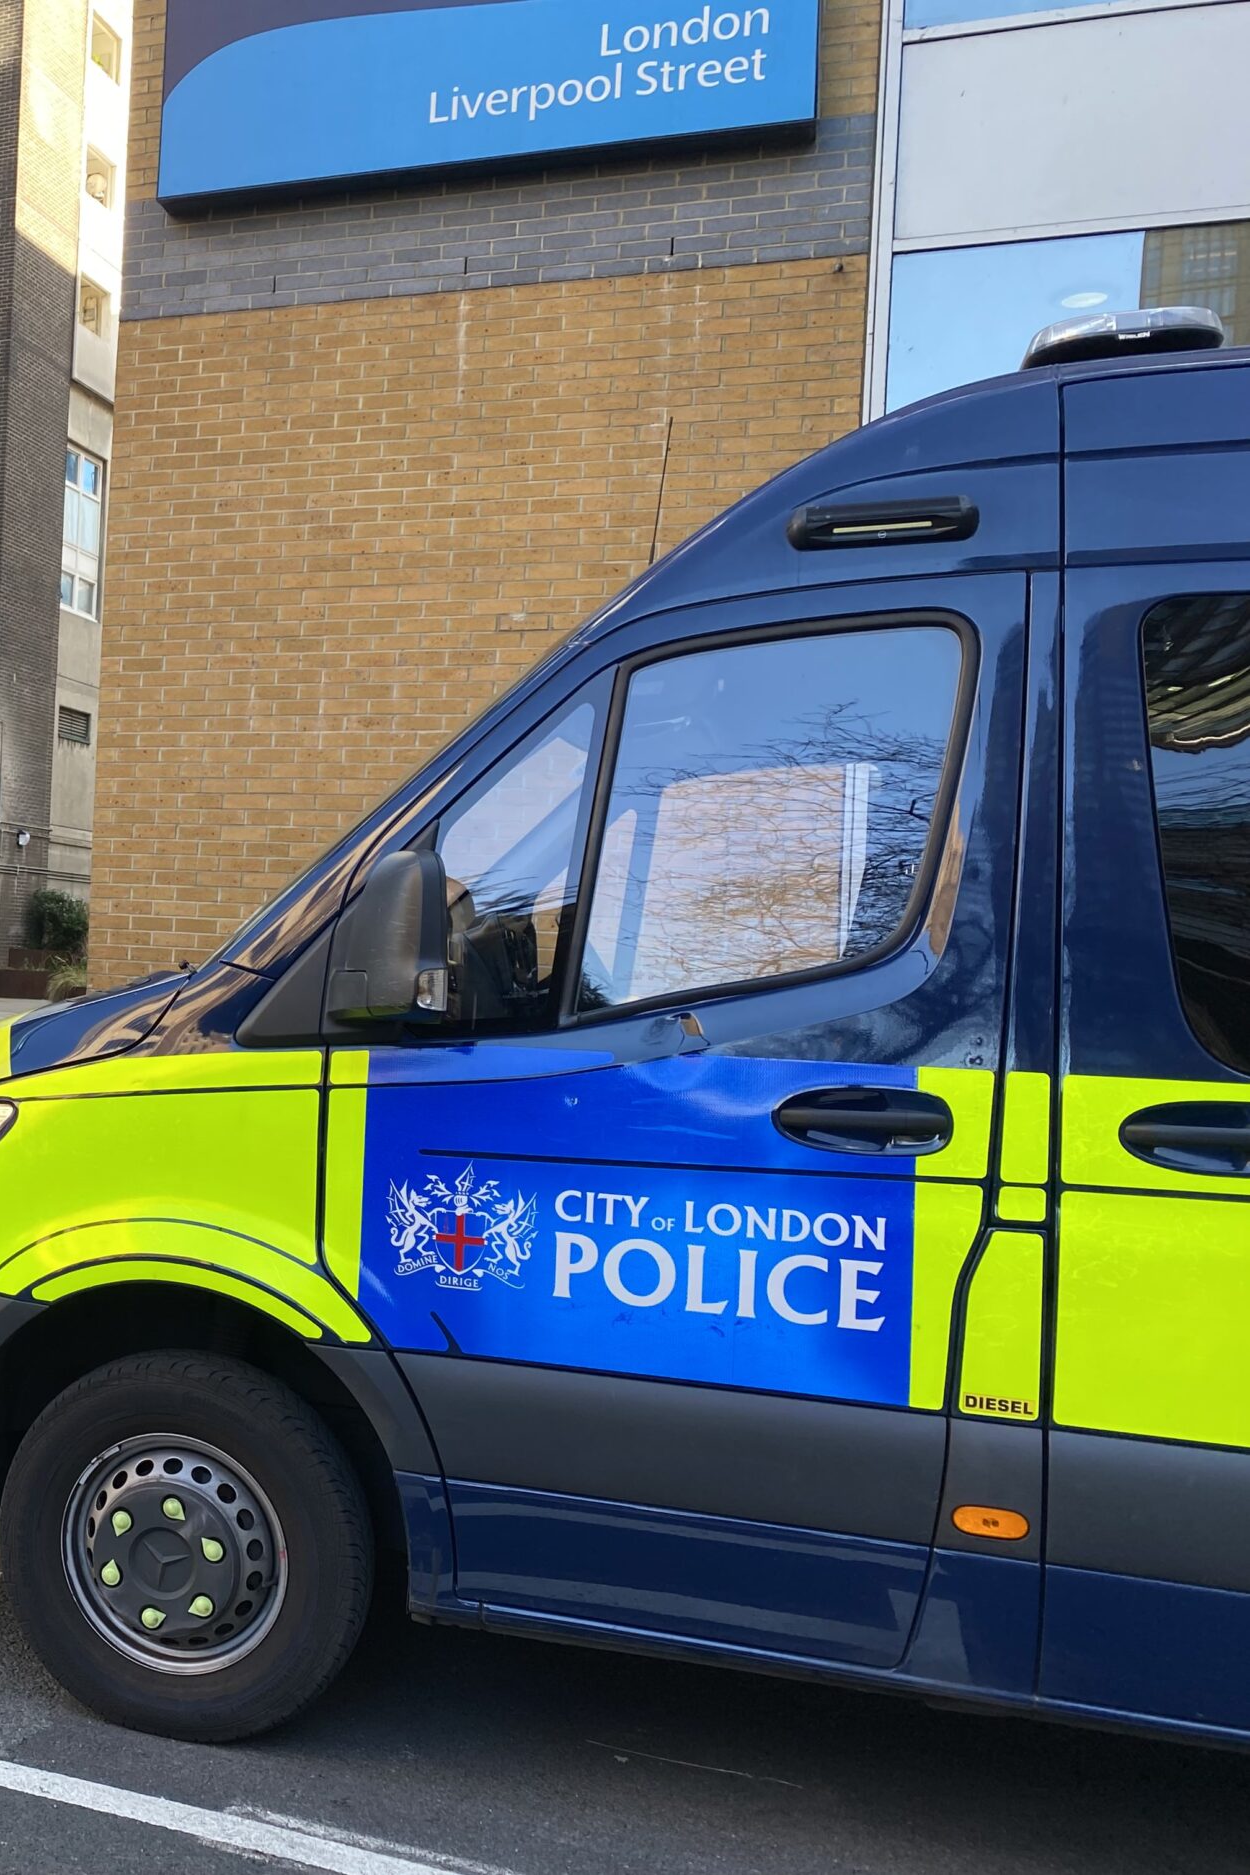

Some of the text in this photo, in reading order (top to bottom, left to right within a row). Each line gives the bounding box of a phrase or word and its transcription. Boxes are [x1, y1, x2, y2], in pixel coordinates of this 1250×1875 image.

[600, 5, 770, 56] London
[429, 49, 767, 123] Liverpool Street
[554, 1189, 887, 1251] CITY OF LONDON
[397, 1254, 511, 1281] DOMINE NOS
[440, 1275, 479, 1288] DIRIGE
[552, 1231, 887, 1332] POLICE
[965, 1395, 1034, 1416] DIESEL
